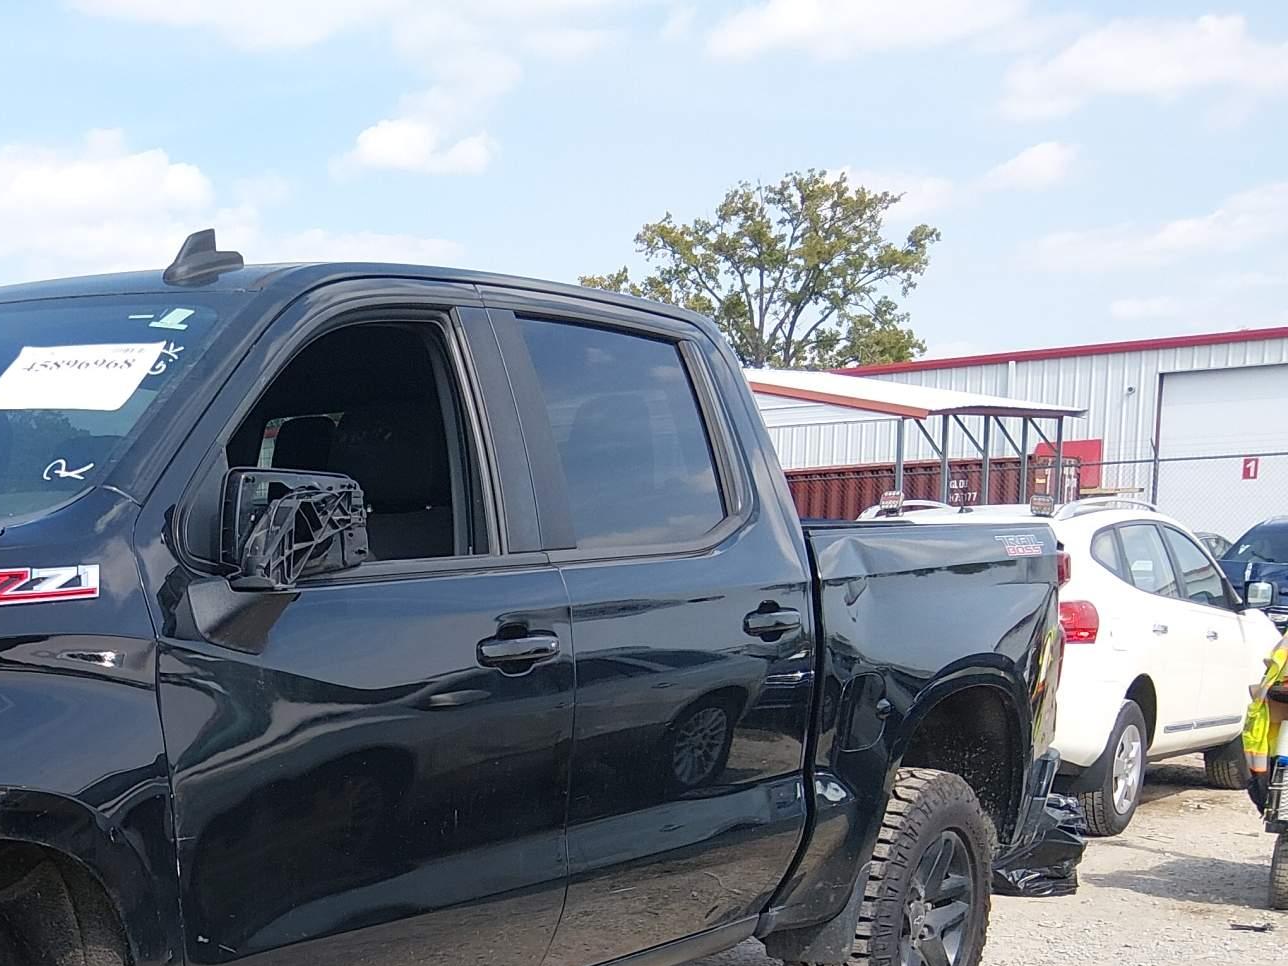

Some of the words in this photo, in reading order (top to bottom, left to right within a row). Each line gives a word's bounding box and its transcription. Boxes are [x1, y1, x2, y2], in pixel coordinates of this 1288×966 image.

[1246, 460, 1256, 477] 1
[994, 534, 1044, 546] TRAIL
[1006, 545, 1043, 556] BOSS
